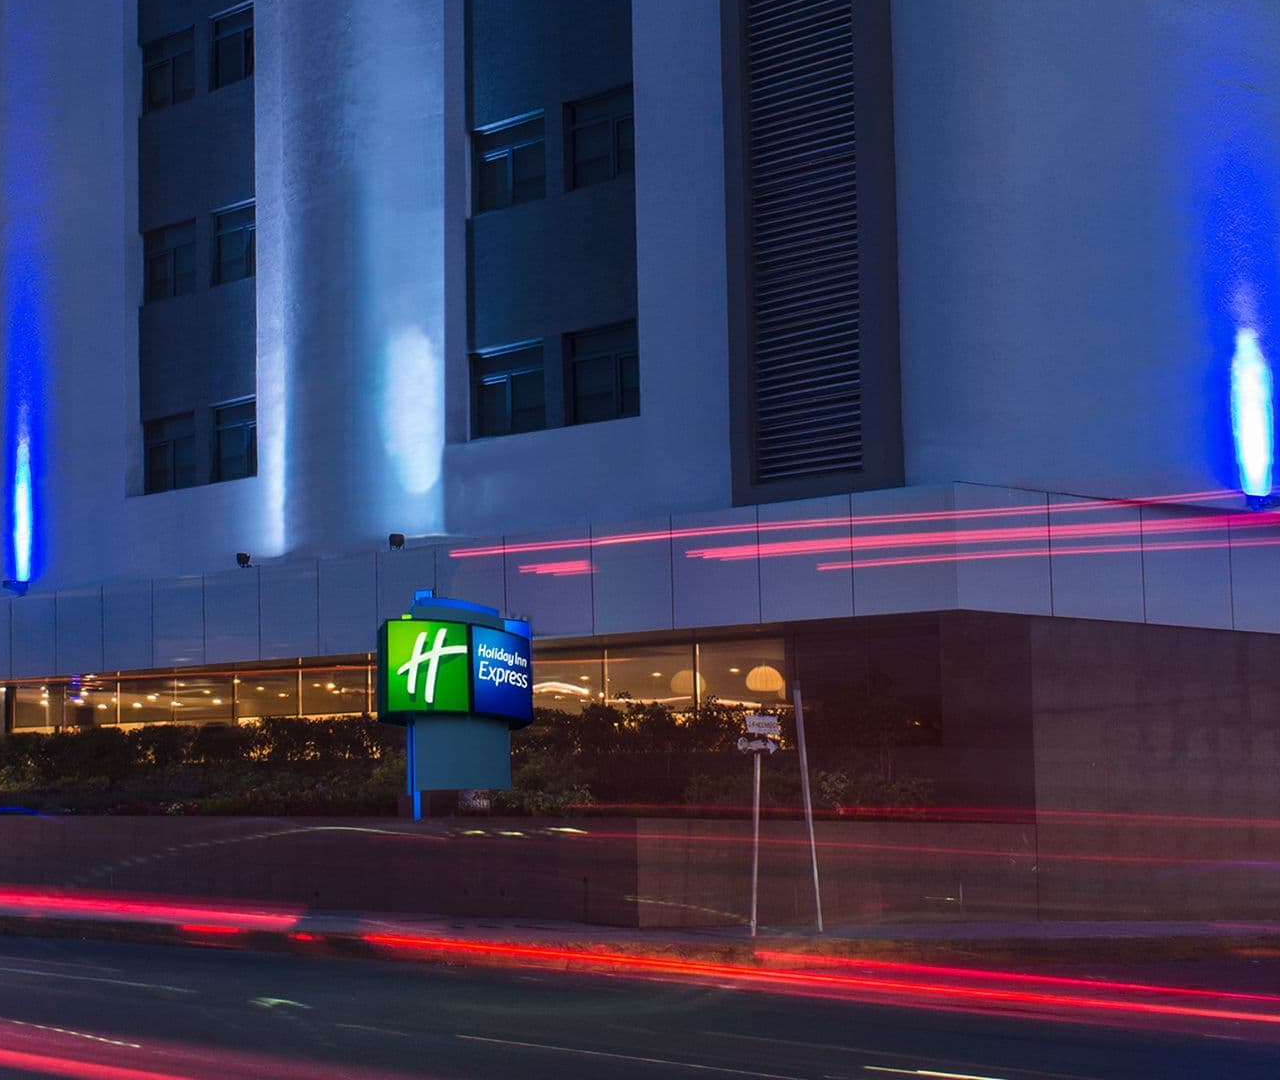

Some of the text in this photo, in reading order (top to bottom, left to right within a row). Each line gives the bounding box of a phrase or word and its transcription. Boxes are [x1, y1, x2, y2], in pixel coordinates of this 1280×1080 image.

[478, 643, 527, 668] Holiday Inn
[478, 660, 528, 688] Express
